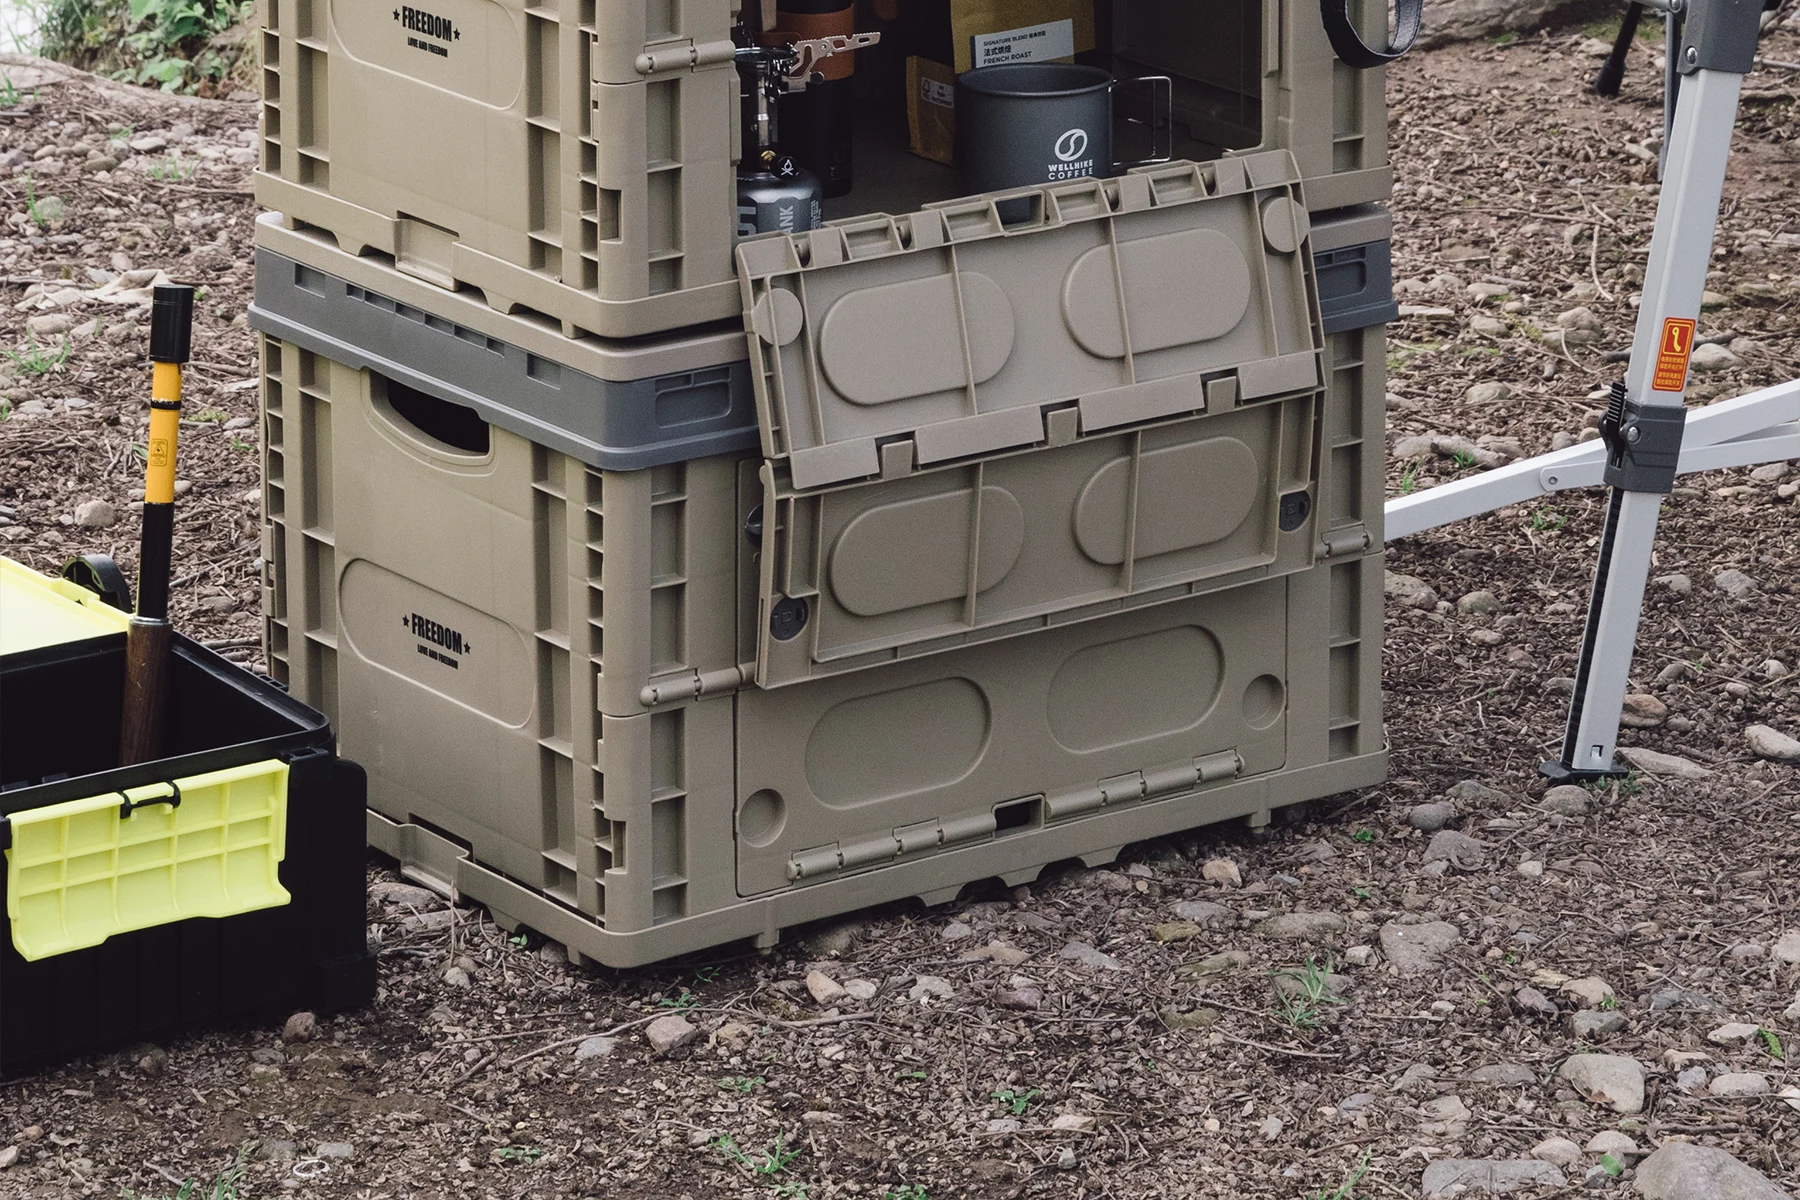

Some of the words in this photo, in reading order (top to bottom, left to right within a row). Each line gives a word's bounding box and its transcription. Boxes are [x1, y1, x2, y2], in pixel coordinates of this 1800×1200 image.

[402, 5, 452, 42] FREEDOM
[983, 37, 1011, 47] SIGNATURE
[983, 55, 1010, 65] FRENCH
[1011, 50, 1032, 61] ROAST
[1048, 159, 1093, 172] WELLHIKE
[1048, 167, 1093, 180] COFFEE
[411, 612, 462, 655] FREEDOM
